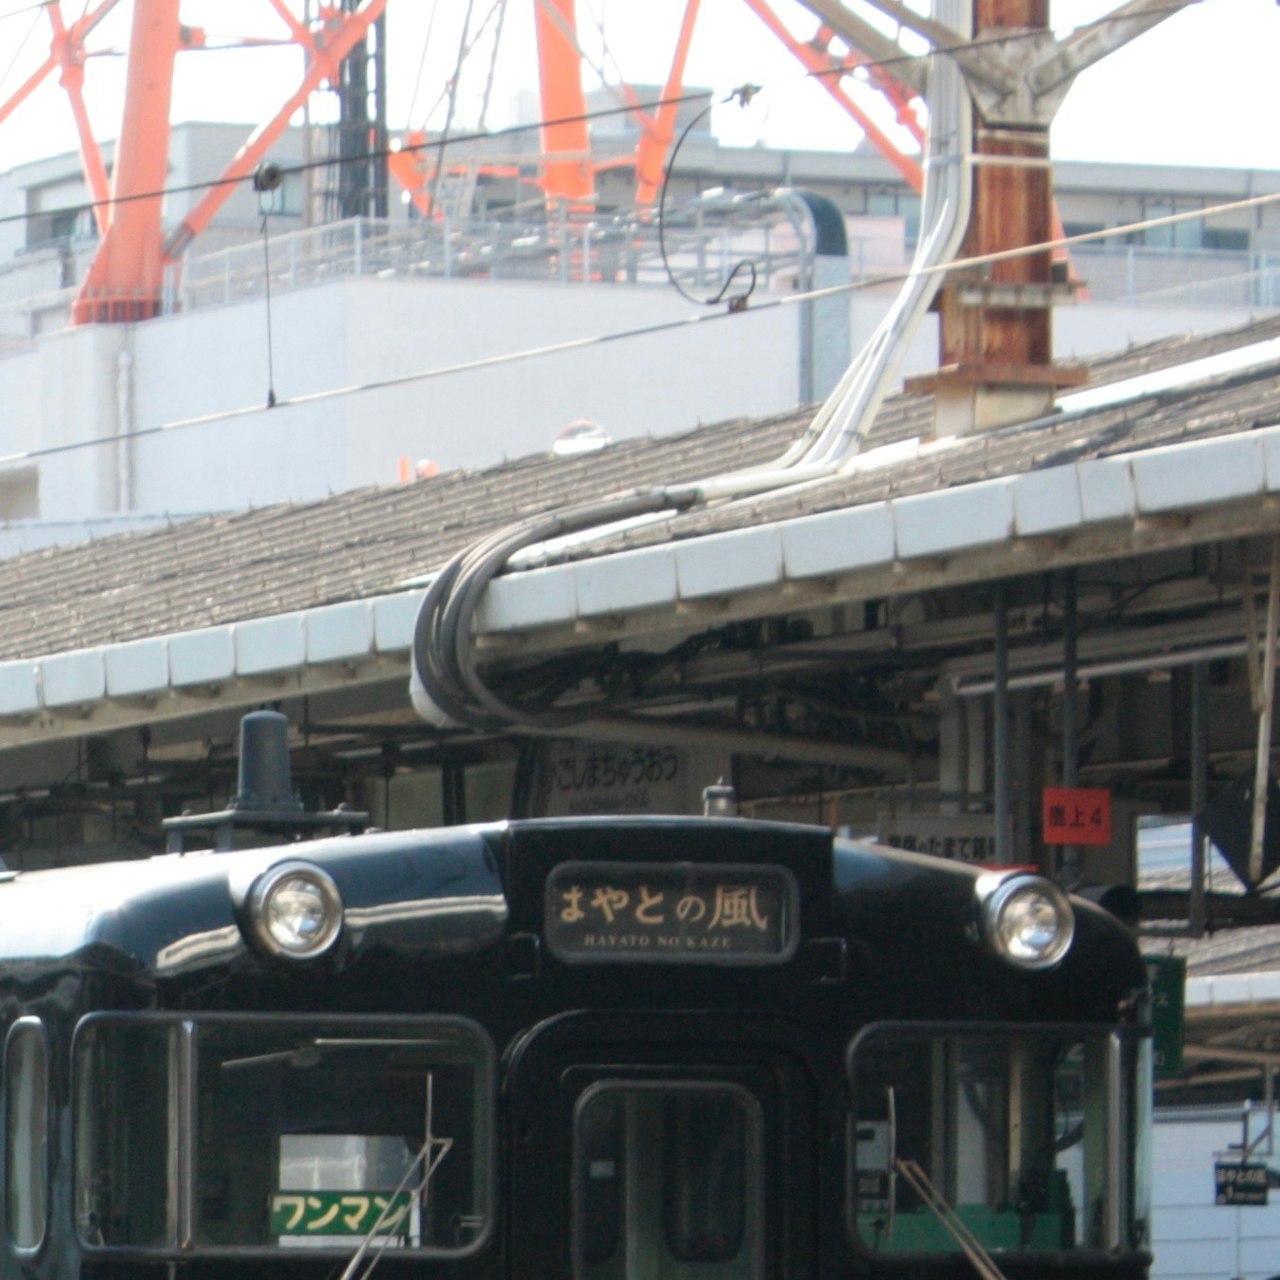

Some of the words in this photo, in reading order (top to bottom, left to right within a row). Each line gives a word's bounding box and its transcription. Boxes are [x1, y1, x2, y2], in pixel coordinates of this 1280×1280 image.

[584, 934, 650, 946] HAYATO
[658, 934, 680, 947] NO
[686, 935, 731, 948] KAZE
[273, 1195, 407, 1230] ワンマン
